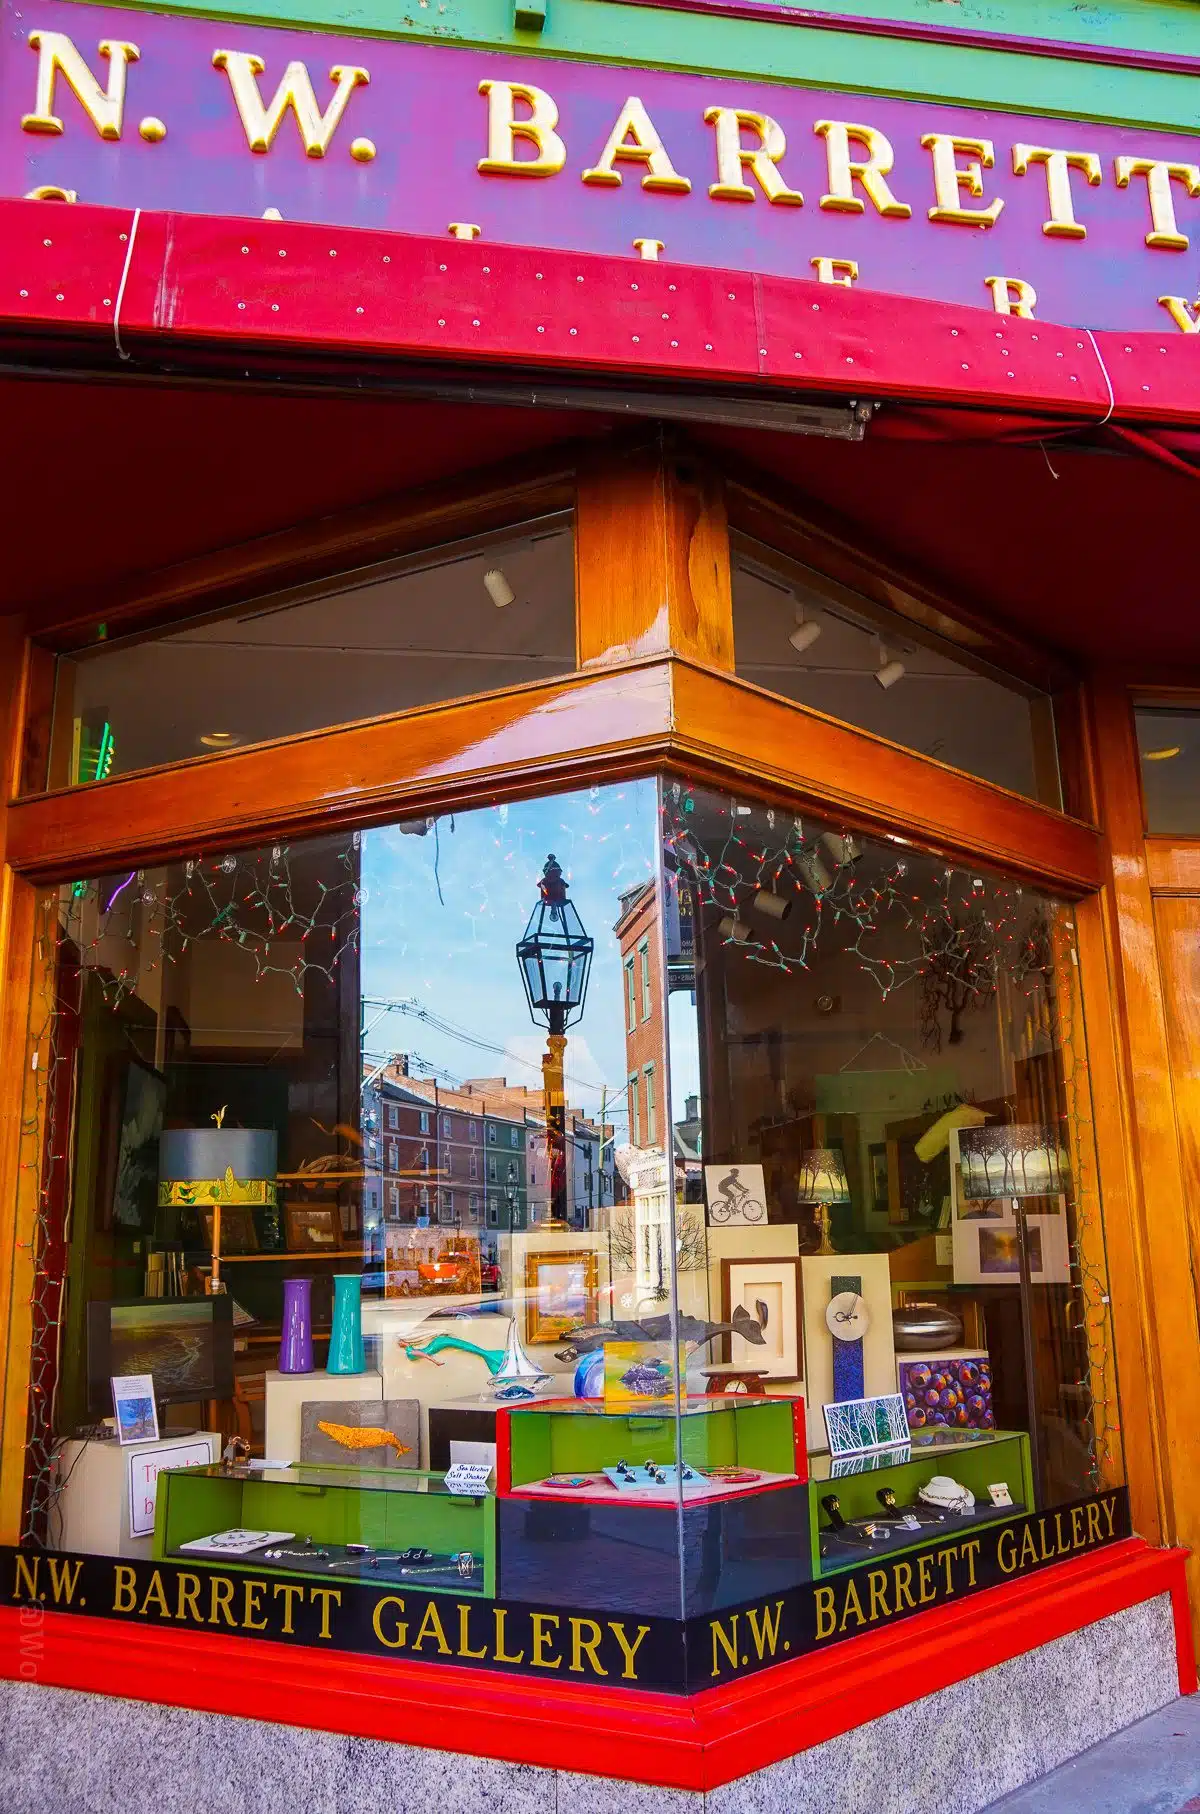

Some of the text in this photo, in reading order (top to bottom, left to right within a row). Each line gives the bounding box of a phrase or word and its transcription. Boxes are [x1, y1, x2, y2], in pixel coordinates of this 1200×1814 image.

[20, 29, 1200, 252] N. W. BARRETT
[112, 1565, 342, 1639] BARRETT
[372, 1595, 651, 1680] GALLERY
[814, 1539, 981, 1640] BARRETT
[996, 1496, 1118, 1573] GALLERY
